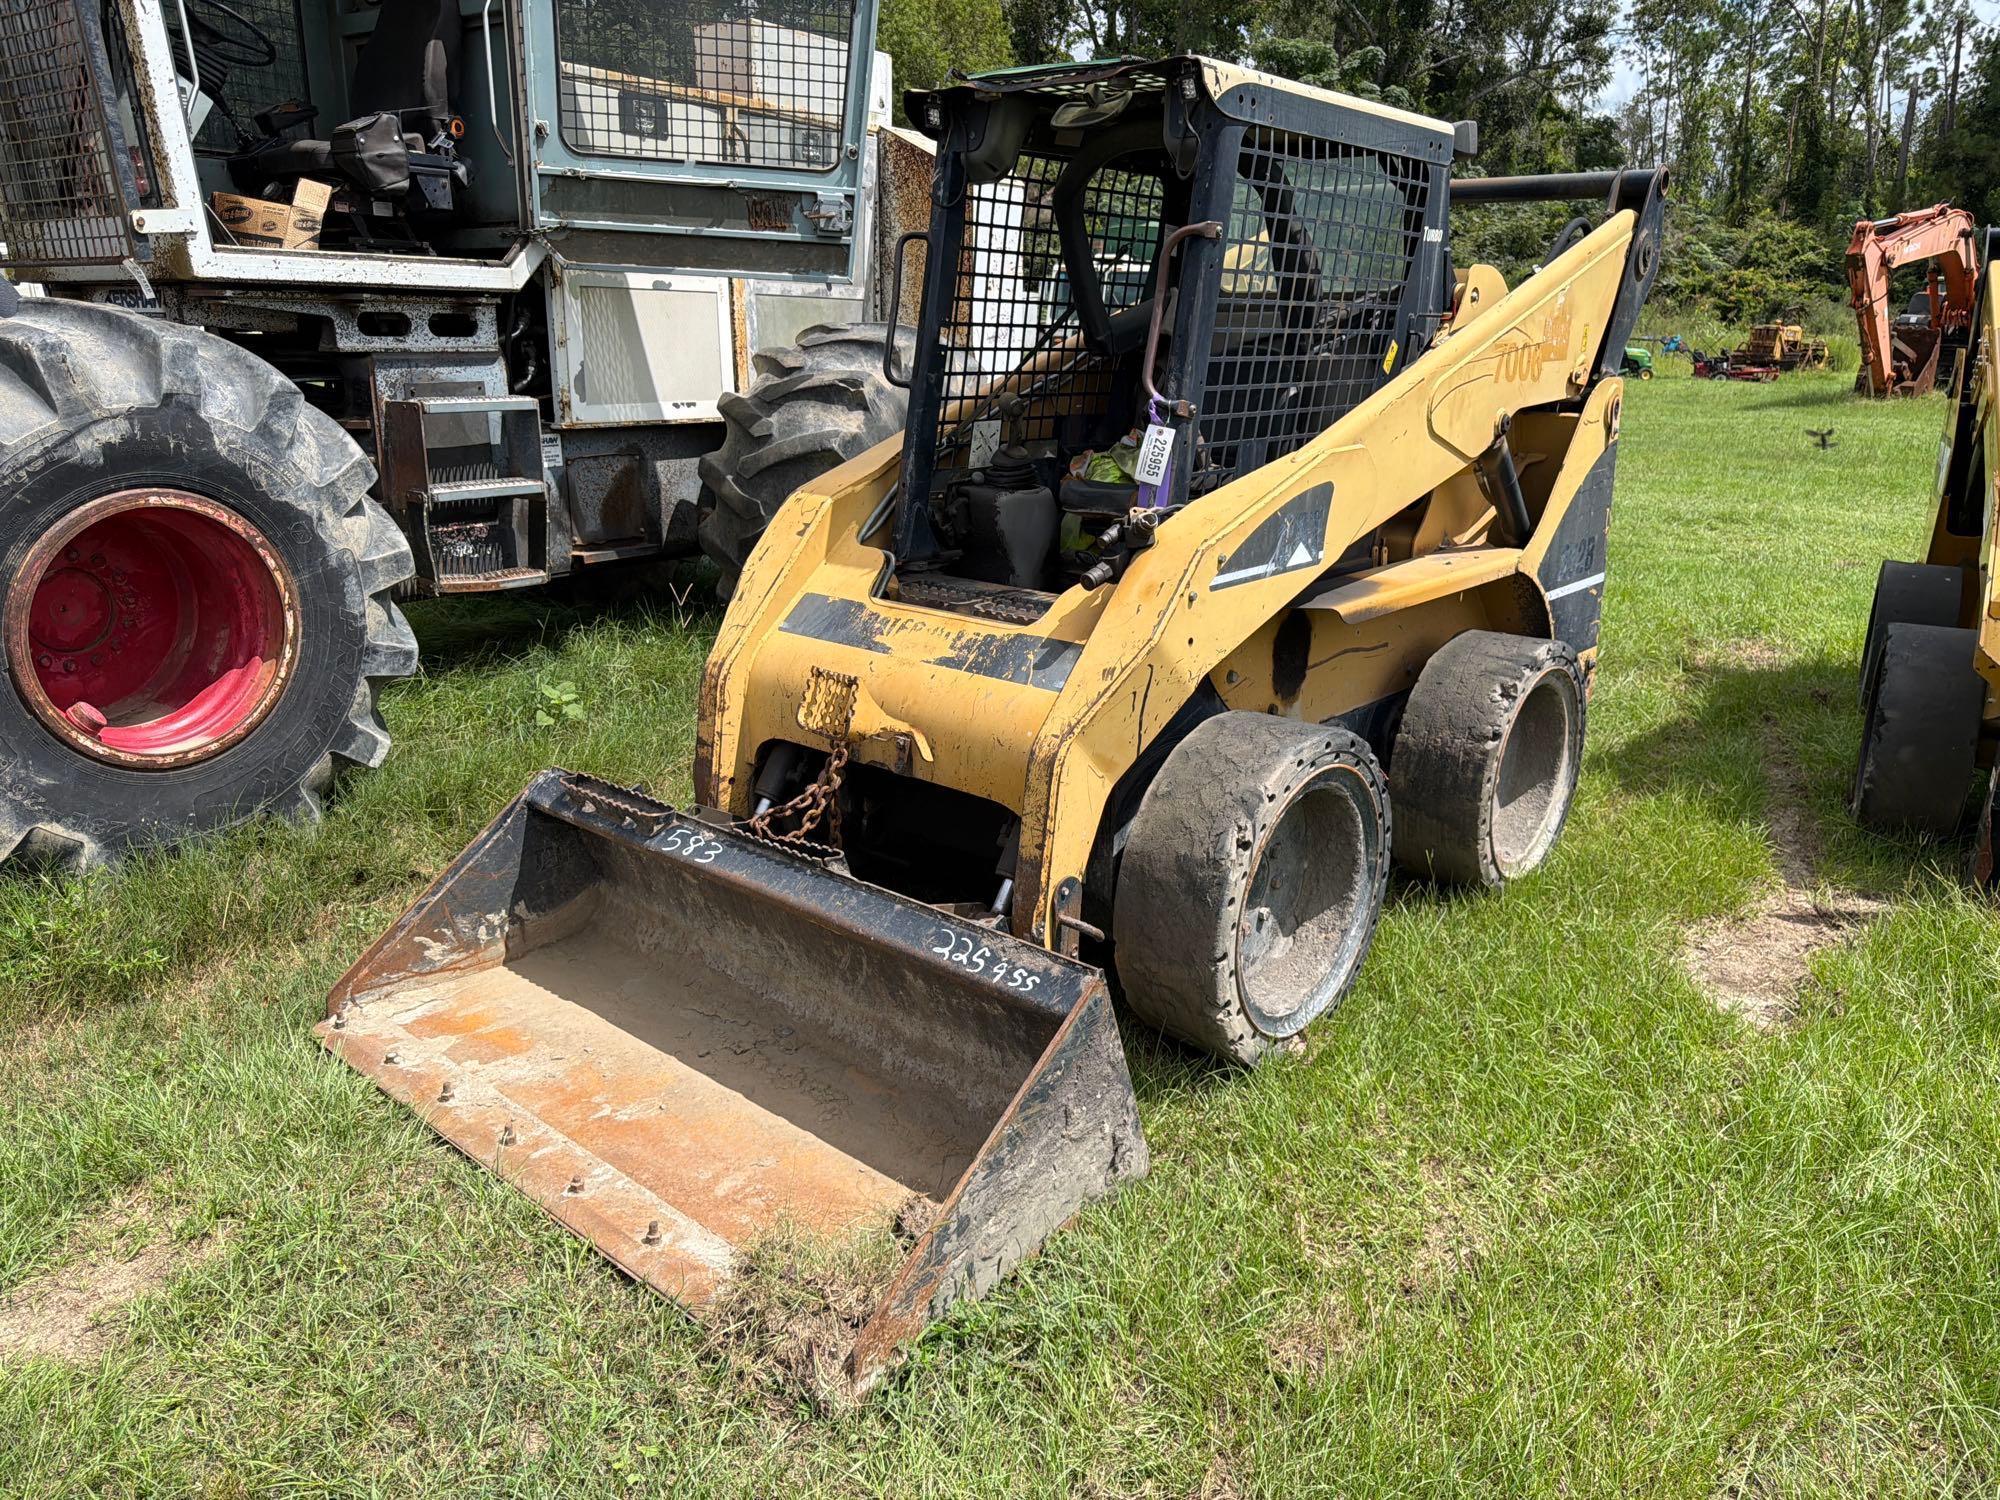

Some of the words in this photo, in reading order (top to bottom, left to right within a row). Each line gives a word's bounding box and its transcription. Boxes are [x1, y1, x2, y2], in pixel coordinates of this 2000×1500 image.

[1146, 437, 1168, 478] 225955
[661, 829, 723, 863] 583
[932, 928, 1041, 991] 225955
